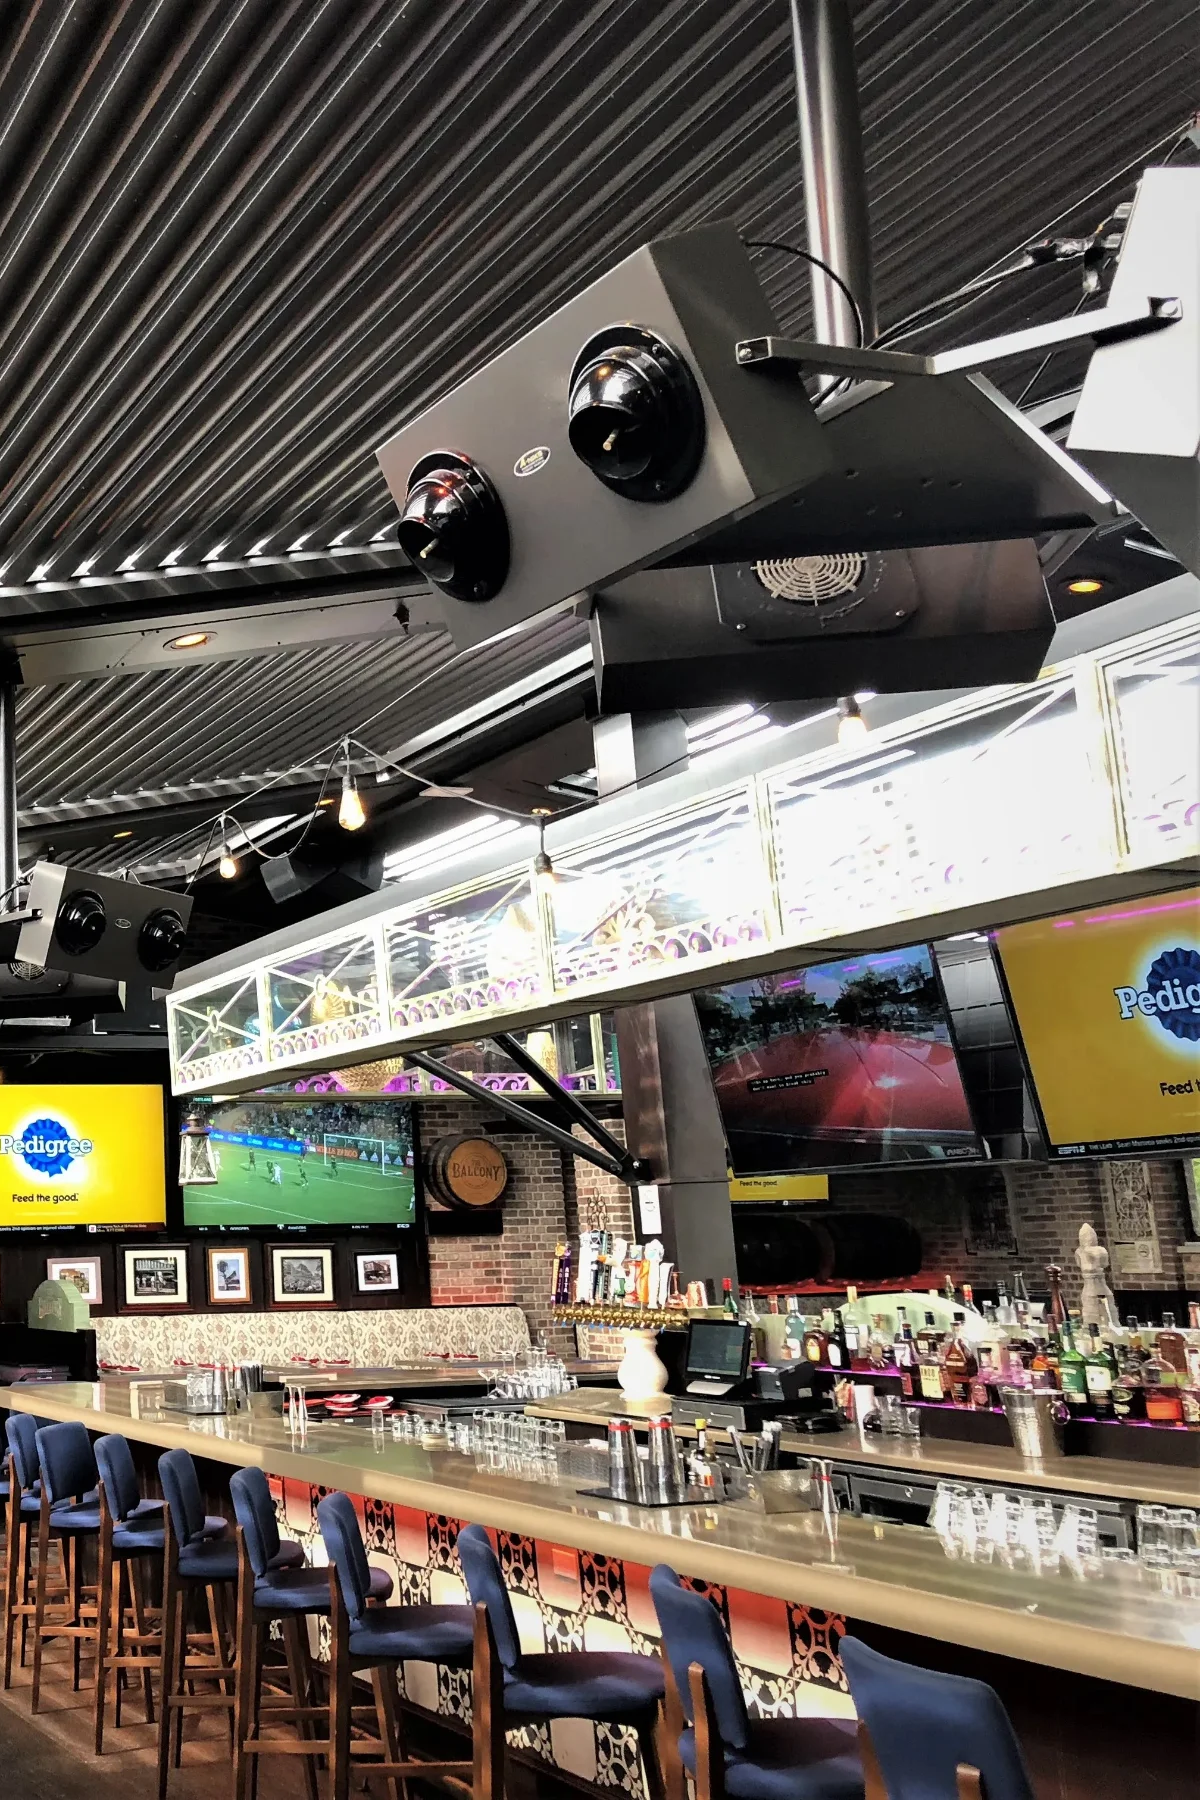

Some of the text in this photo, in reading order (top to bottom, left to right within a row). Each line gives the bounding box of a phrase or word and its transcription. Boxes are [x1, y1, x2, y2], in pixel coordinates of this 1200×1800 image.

[1160, 1080, 1194, 1096] Feed
[452, 1162, 502, 1181] BALCONY
[12, 1193, 34, 1202] Feed
[37, 1193, 50, 1202] the
